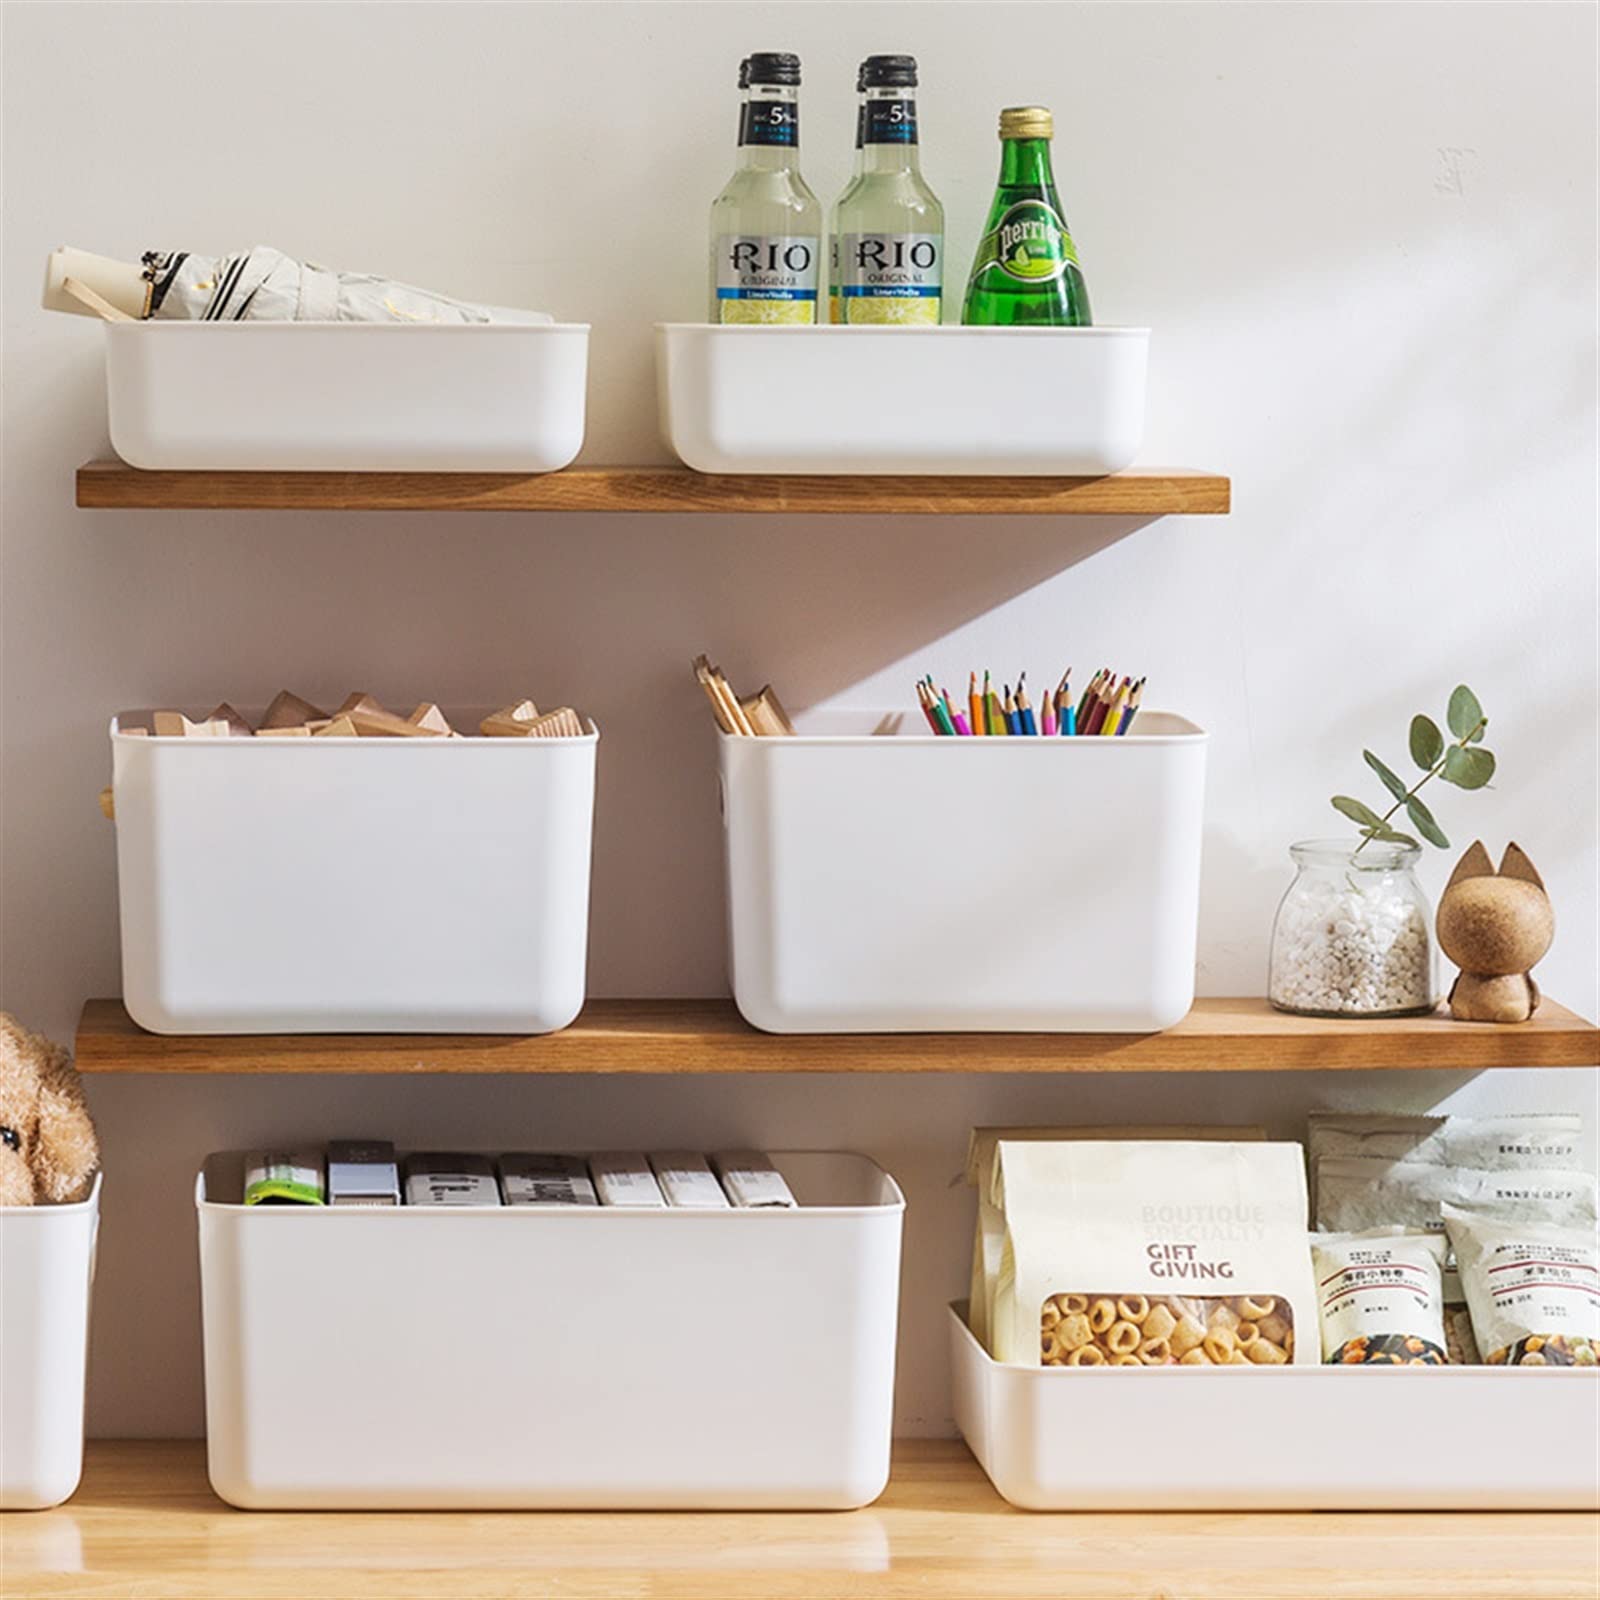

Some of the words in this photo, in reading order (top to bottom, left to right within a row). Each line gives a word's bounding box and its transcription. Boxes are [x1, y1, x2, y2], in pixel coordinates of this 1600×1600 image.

[729, 242, 811, 273] RIO
[855, 240, 936, 271] RIO
[1141, 1204, 1265, 1223] BOUTIQUE
[1146, 1243, 1197, 1261] GIFT
[1149, 1260, 1235, 1279] GIVING
